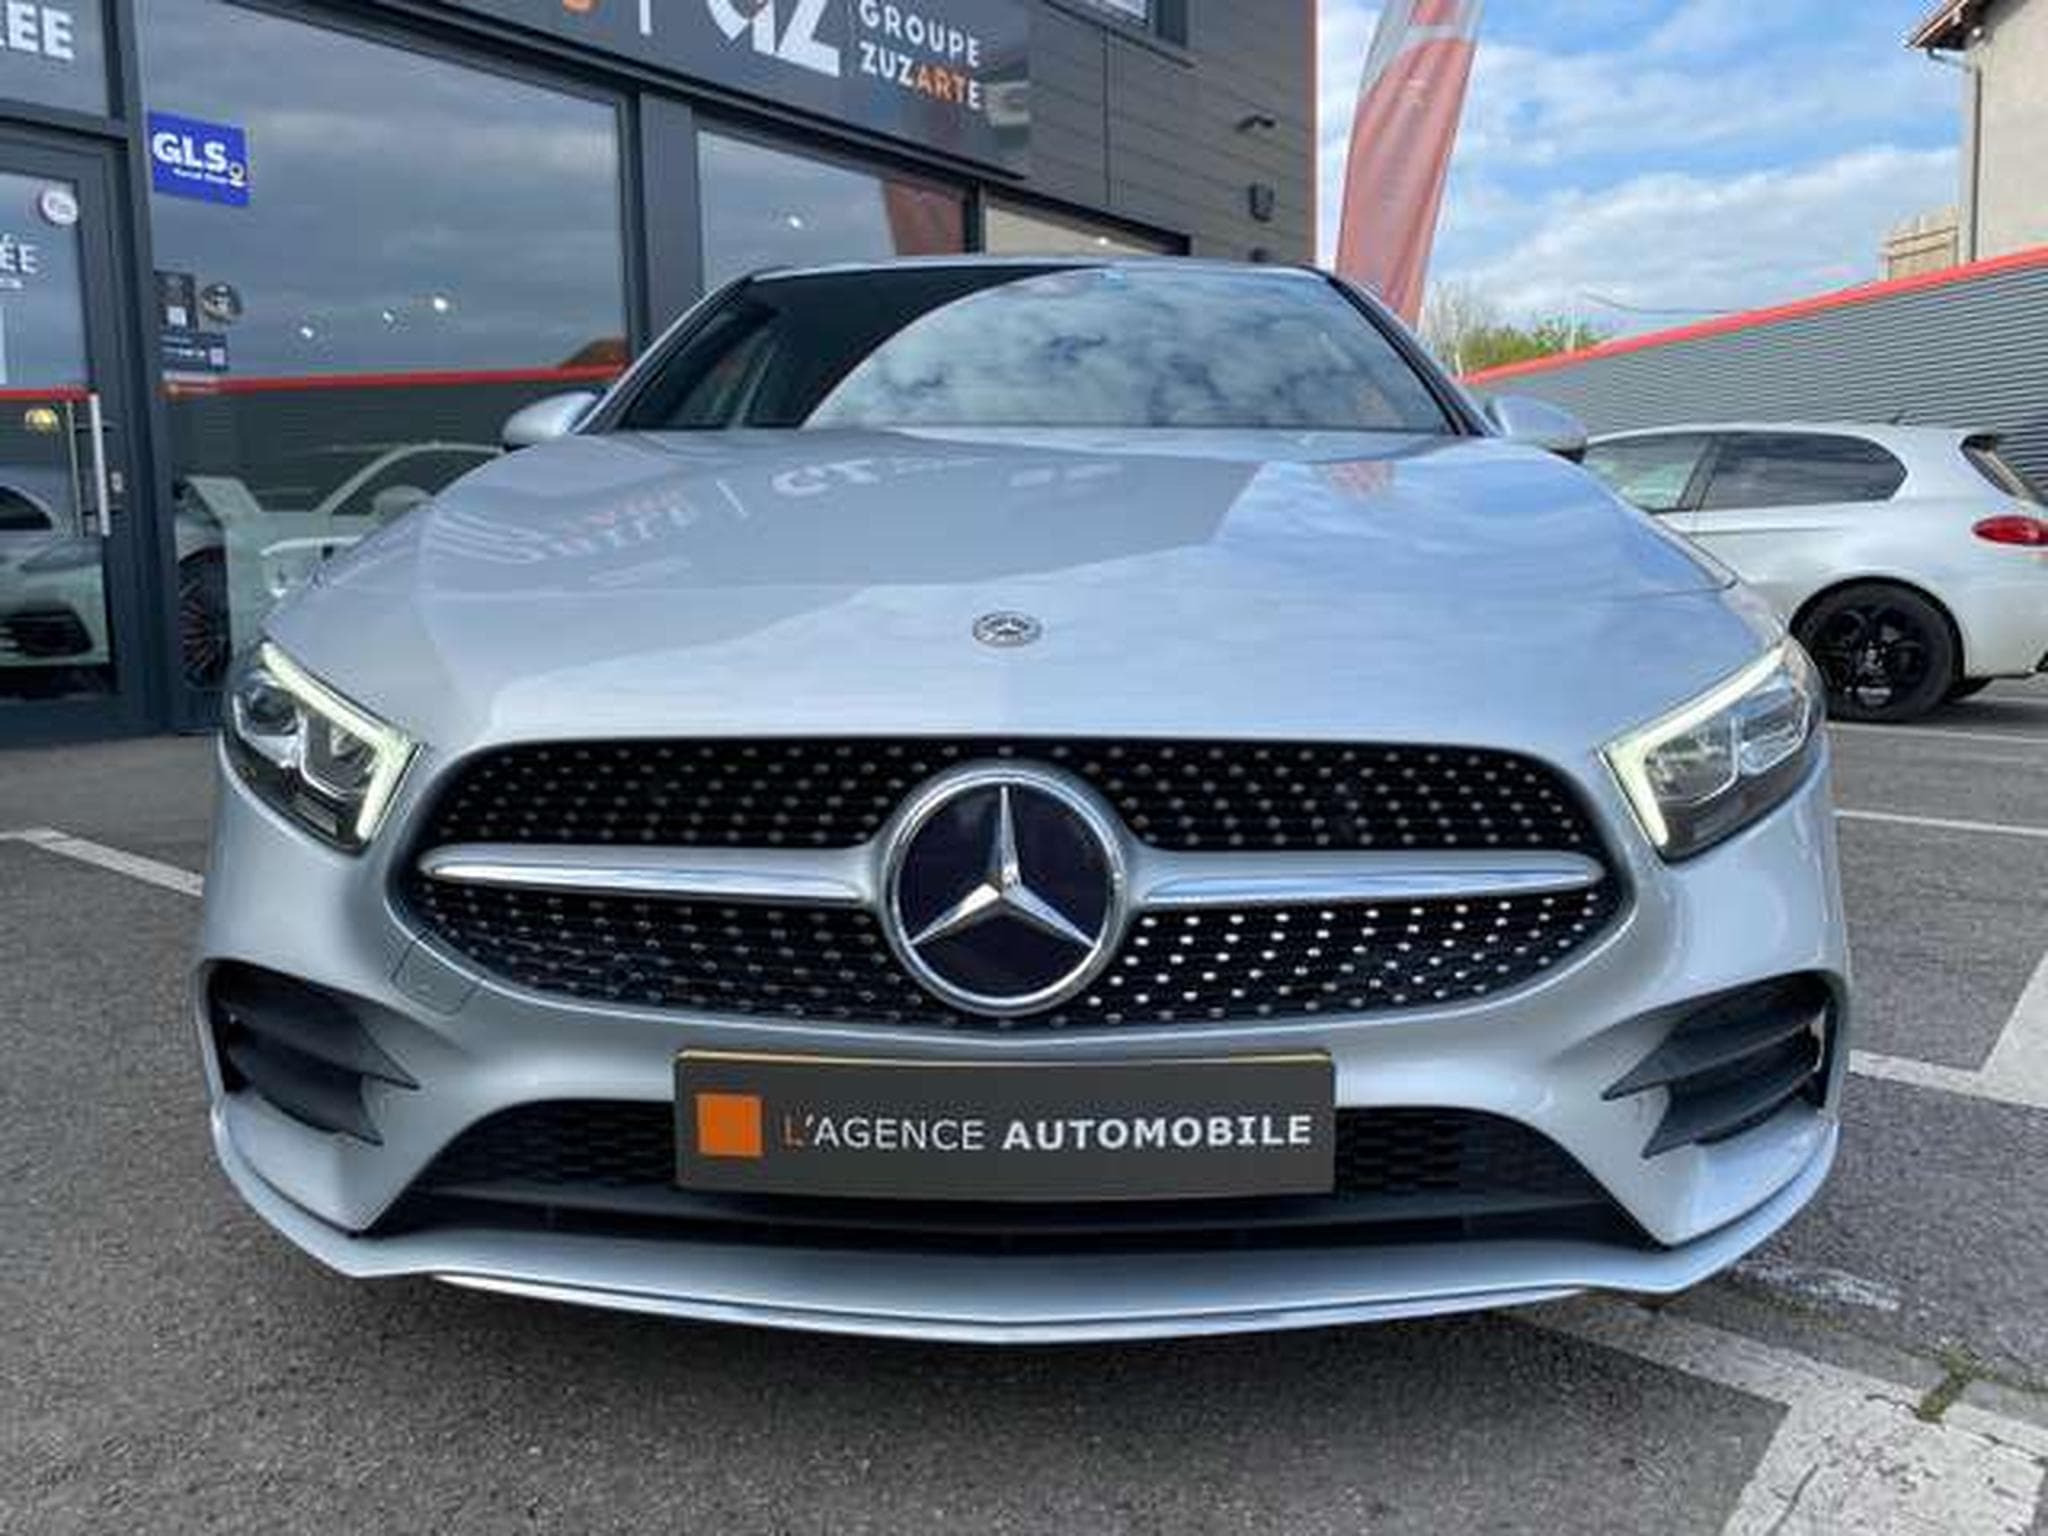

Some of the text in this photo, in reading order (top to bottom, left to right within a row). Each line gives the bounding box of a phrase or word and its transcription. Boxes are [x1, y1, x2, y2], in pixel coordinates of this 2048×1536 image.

[858, 0, 981, 68] GROUPE
[858, 40, 981, 110] ZUZARTE
[782, 1114, 1313, 1152] L'AGENCE AUTOMOBILE
